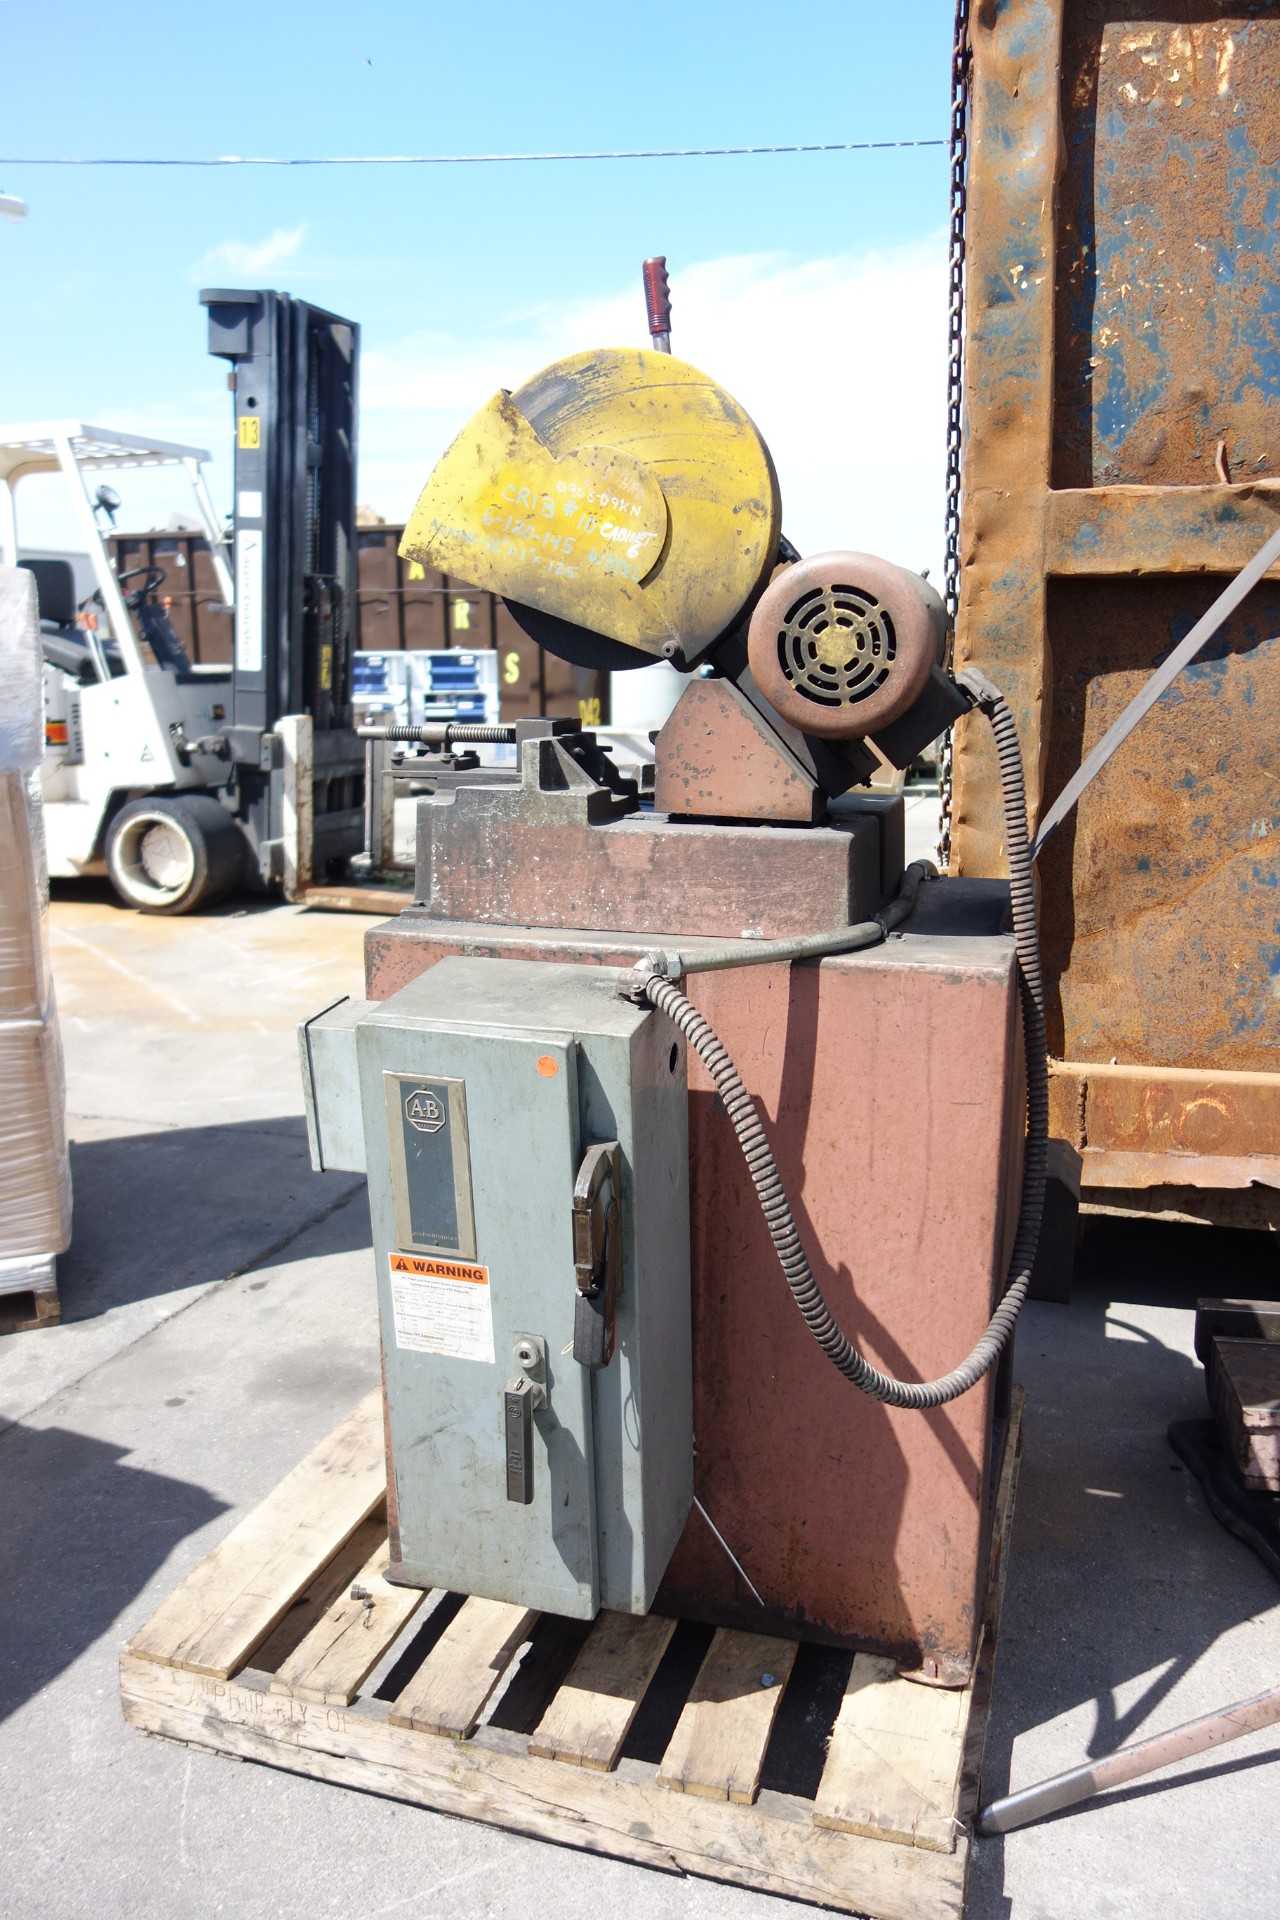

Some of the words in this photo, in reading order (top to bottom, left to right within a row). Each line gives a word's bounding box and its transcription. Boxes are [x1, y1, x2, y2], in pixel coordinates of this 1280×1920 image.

[241, 420, 258, 445] 13
[454, 599, 470, 629] R
[504, 652, 520, 684] S
[413, 1261, 484, 1281] WARNING
